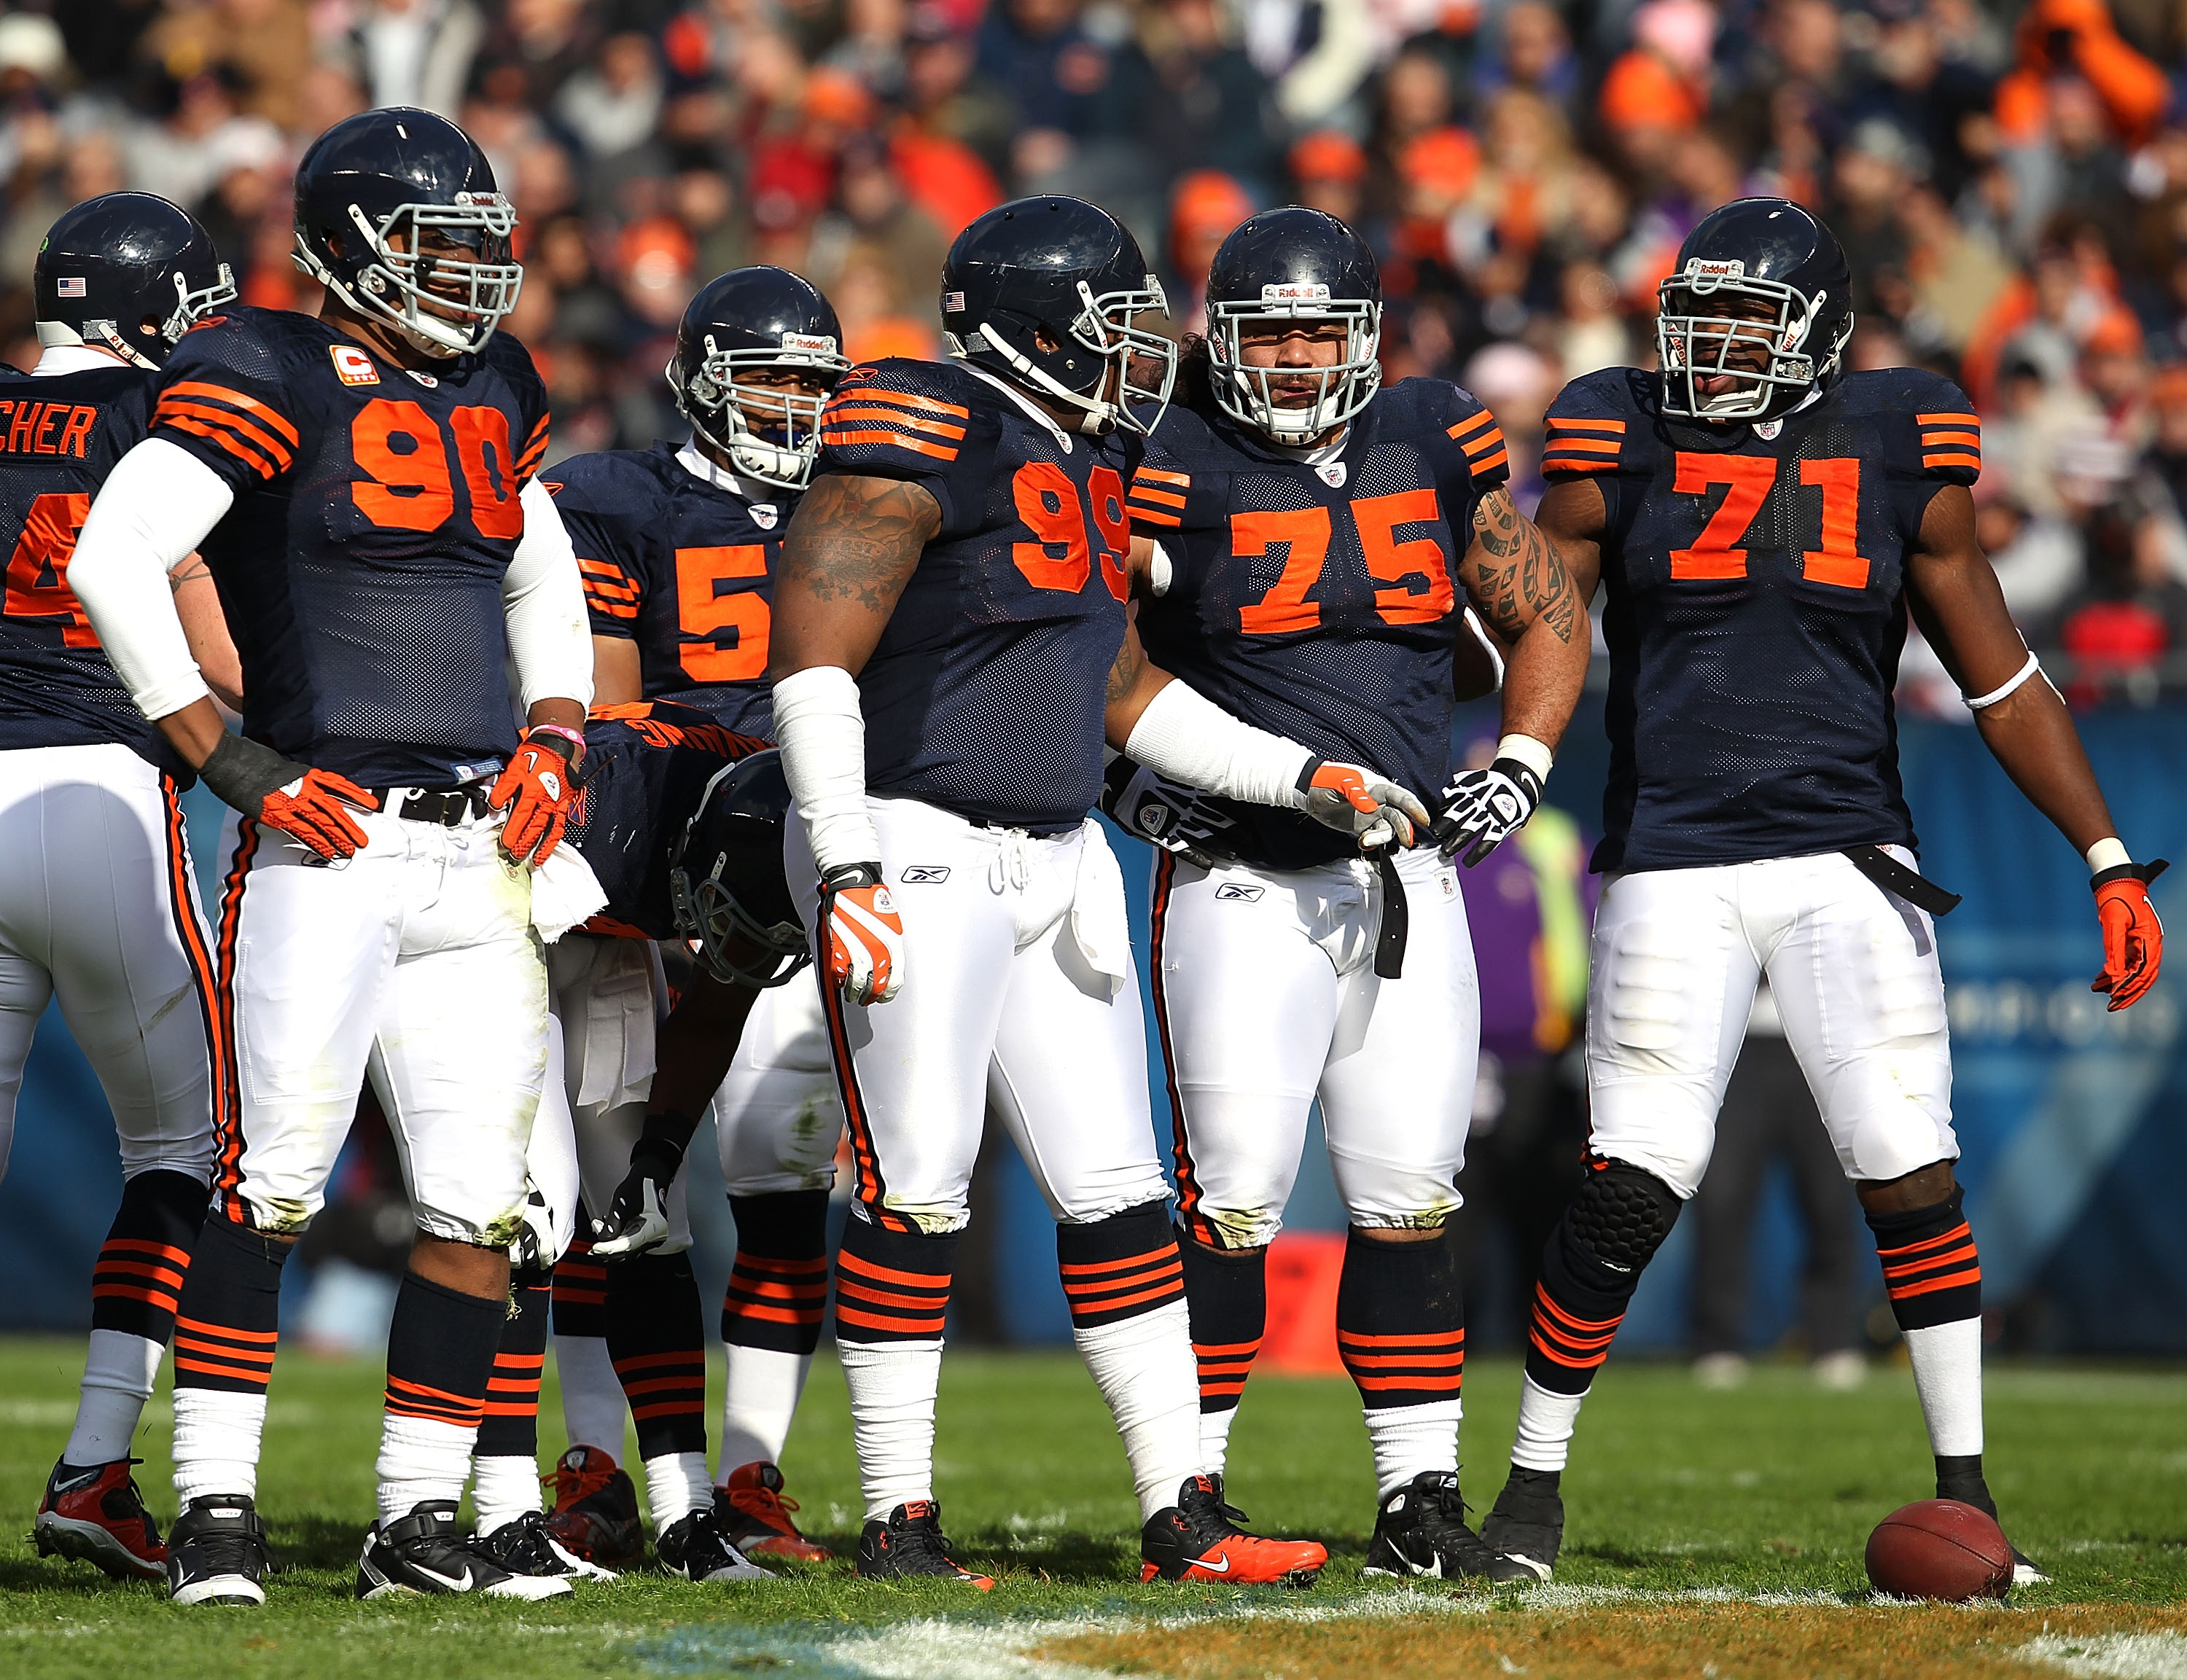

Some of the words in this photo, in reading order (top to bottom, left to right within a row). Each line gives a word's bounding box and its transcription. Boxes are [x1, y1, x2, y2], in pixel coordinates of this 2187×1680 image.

[335, 347, 373, 375] C
[351, 397, 524, 539] 90
[1012, 460, 1131, 605] 99
[1669, 451, 1871, 589] 71
[1230, 488, 1455, 634] 75
